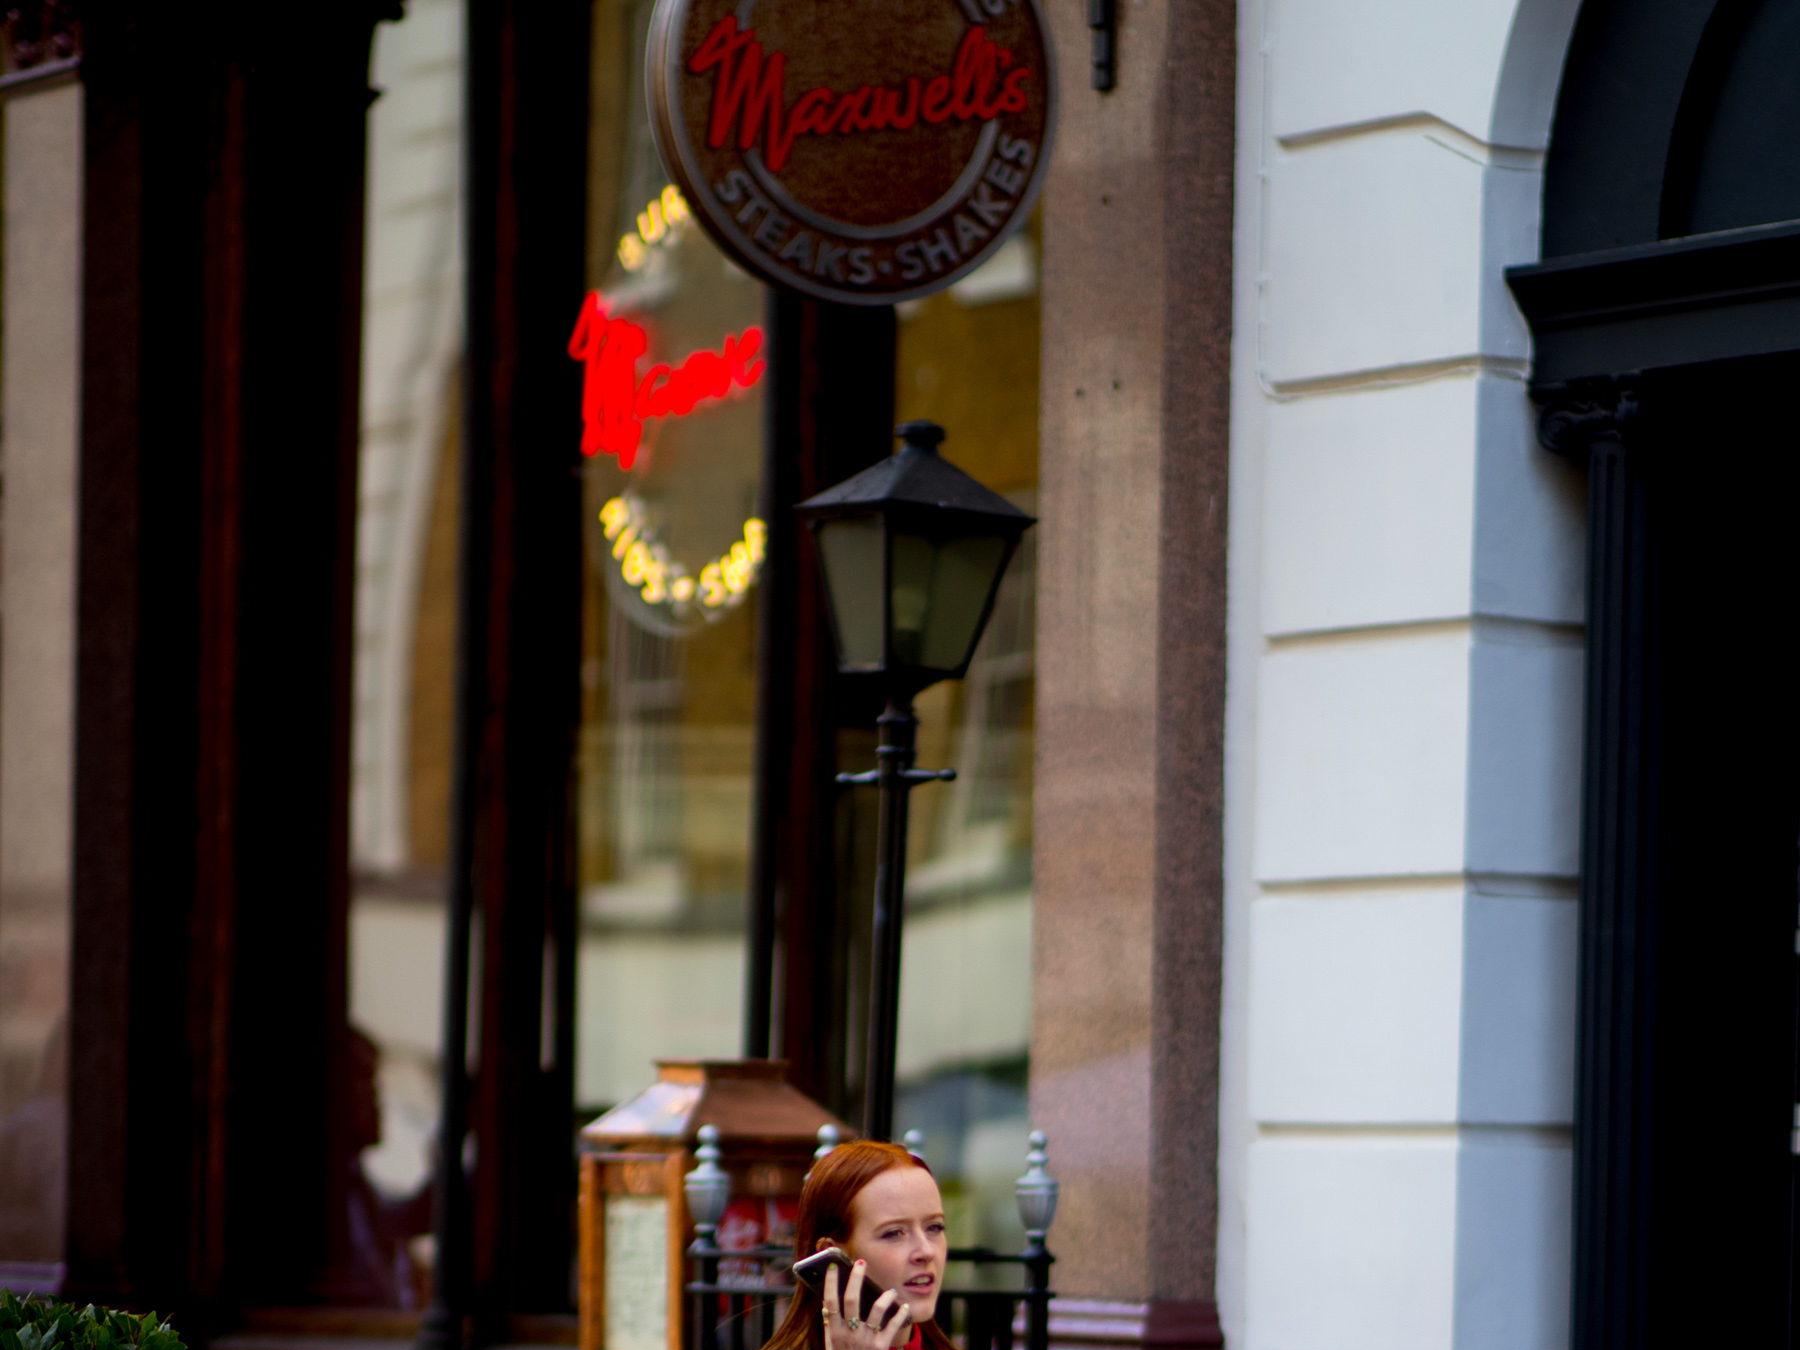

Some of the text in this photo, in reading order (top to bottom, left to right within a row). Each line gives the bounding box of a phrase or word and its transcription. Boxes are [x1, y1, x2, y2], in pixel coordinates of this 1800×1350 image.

[689, 15, 1032, 172] Maxwell's
[714, 134, 1034, 285] STEAKS SHAKES
